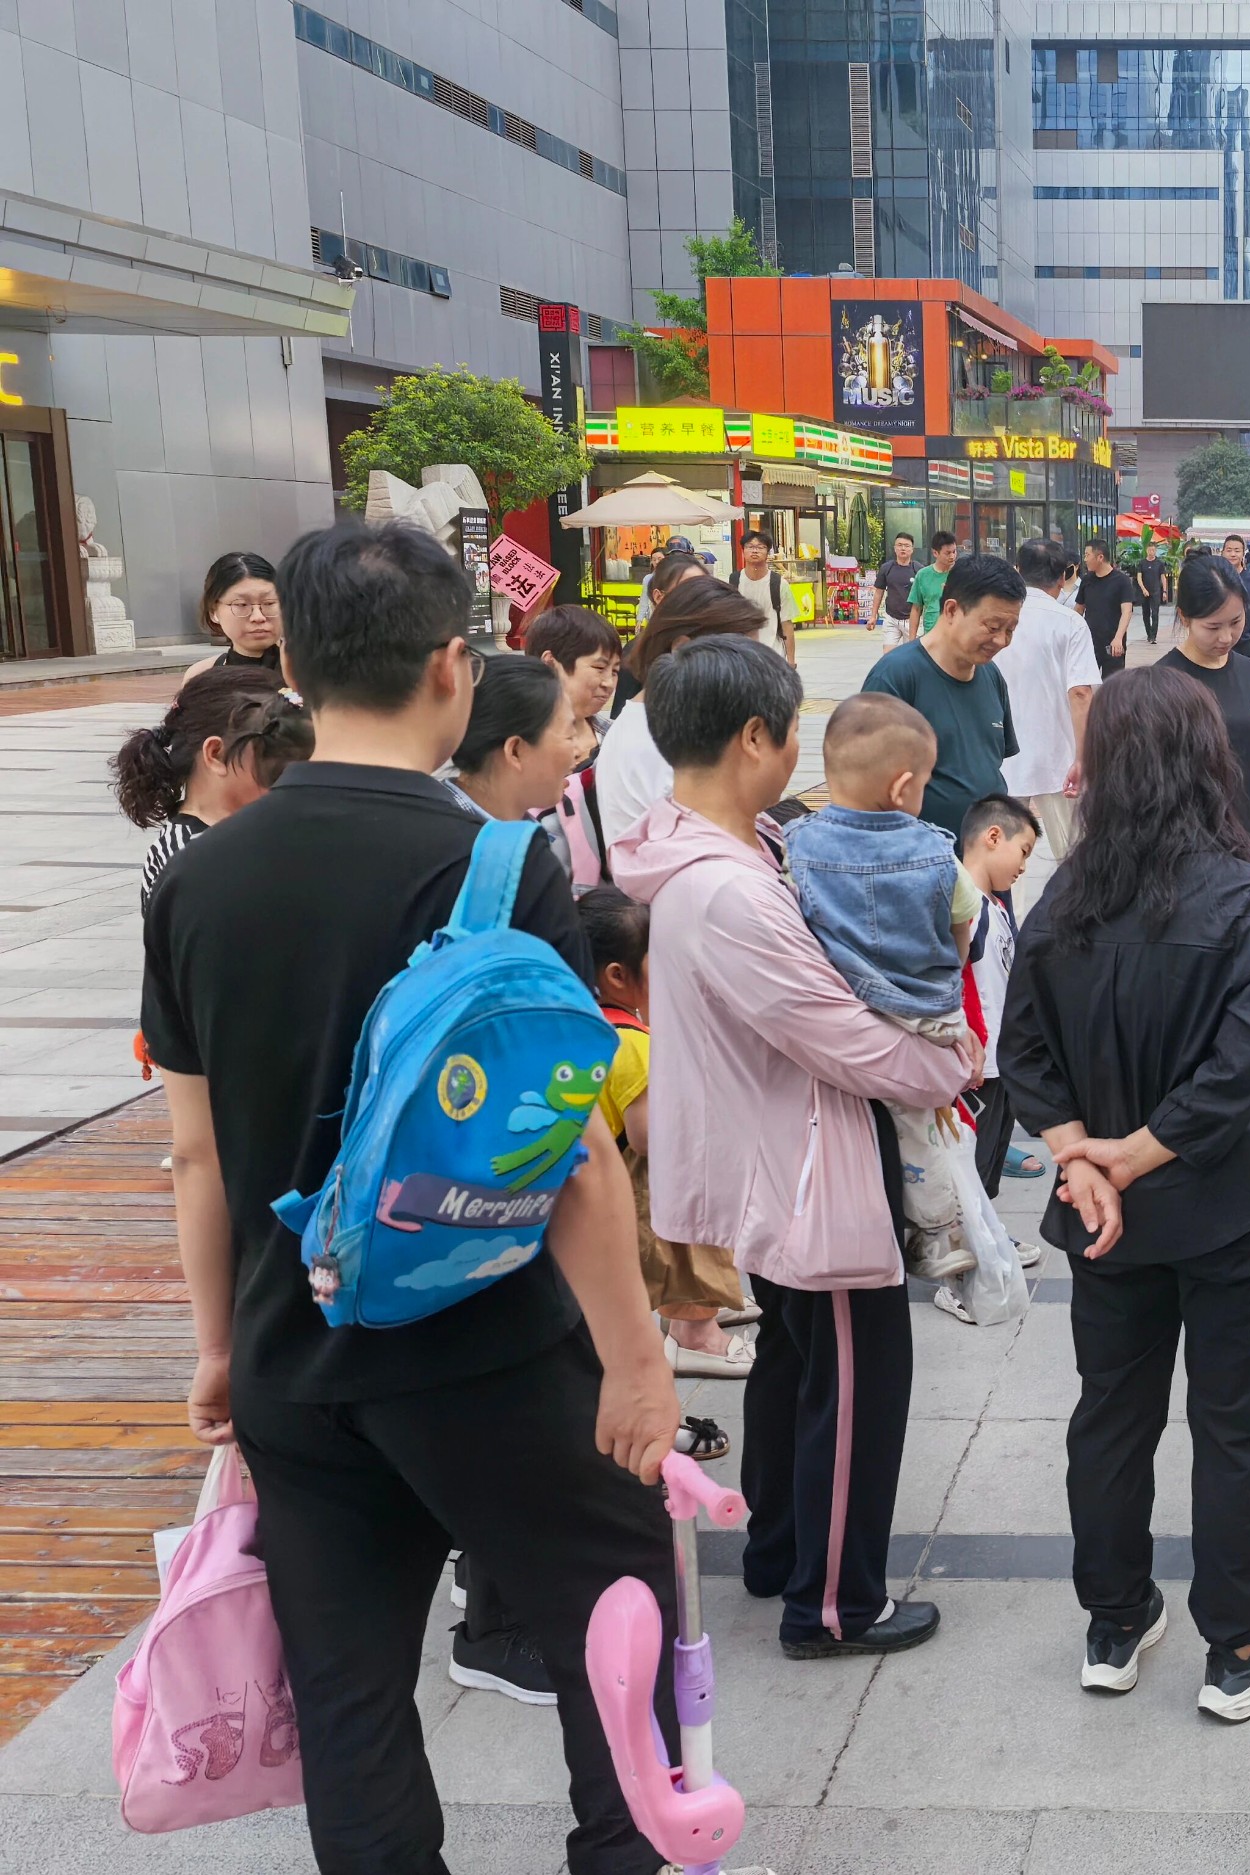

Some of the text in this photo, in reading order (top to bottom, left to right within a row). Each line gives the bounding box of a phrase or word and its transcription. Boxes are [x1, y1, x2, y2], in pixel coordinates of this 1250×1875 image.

[549, 352, 562, 399] XI'AN
[842, 386, 915, 407] MUSIC
[640, 422, 716, 437] 营养早餐
[1000, 435, 1044, 459] Vista
[1048, 435, 1077, 460] Bar
[500, 548, 518, 568] BASED
[501, 555, 522, 575] BLOCK
